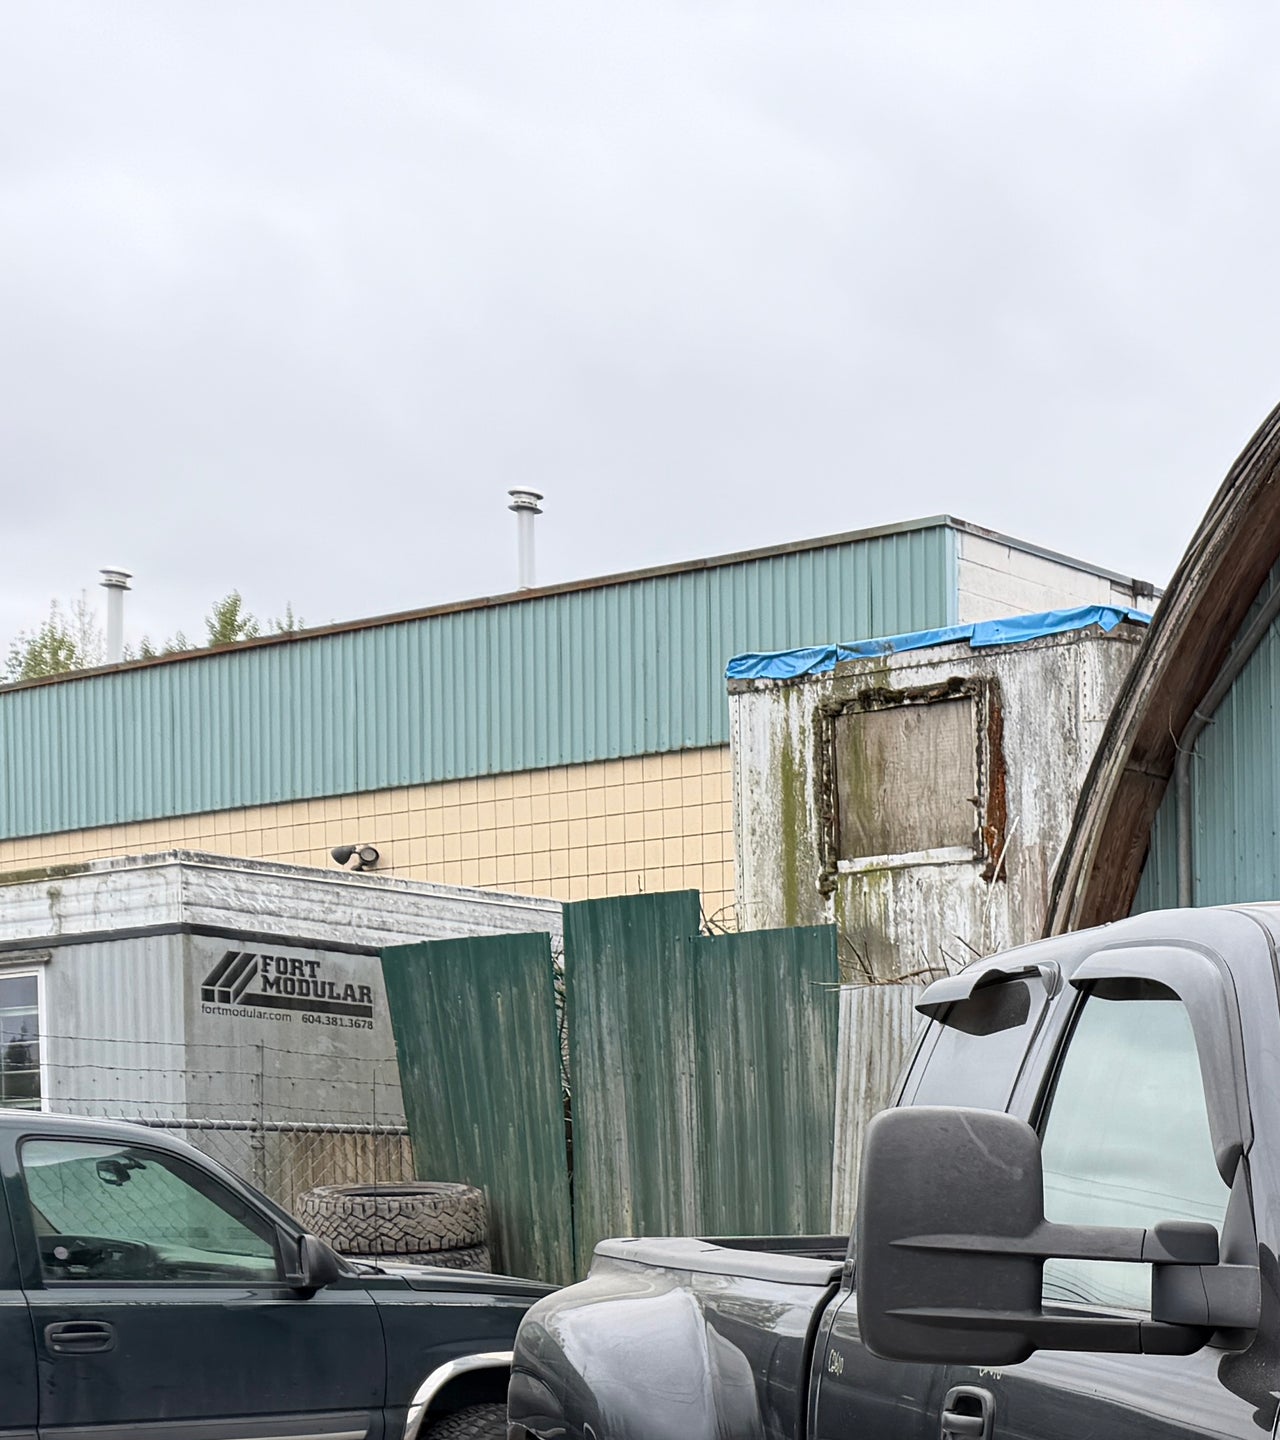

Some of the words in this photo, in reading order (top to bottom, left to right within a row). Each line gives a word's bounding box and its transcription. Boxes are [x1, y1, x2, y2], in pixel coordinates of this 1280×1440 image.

[260, 954, 321, 979] FORT
[260, 973, 373, 1004] MODULAR
[201, 1003, 292, 1023] fortmodular.com
[301, 1013, 373, 1030] 604.381.3678
